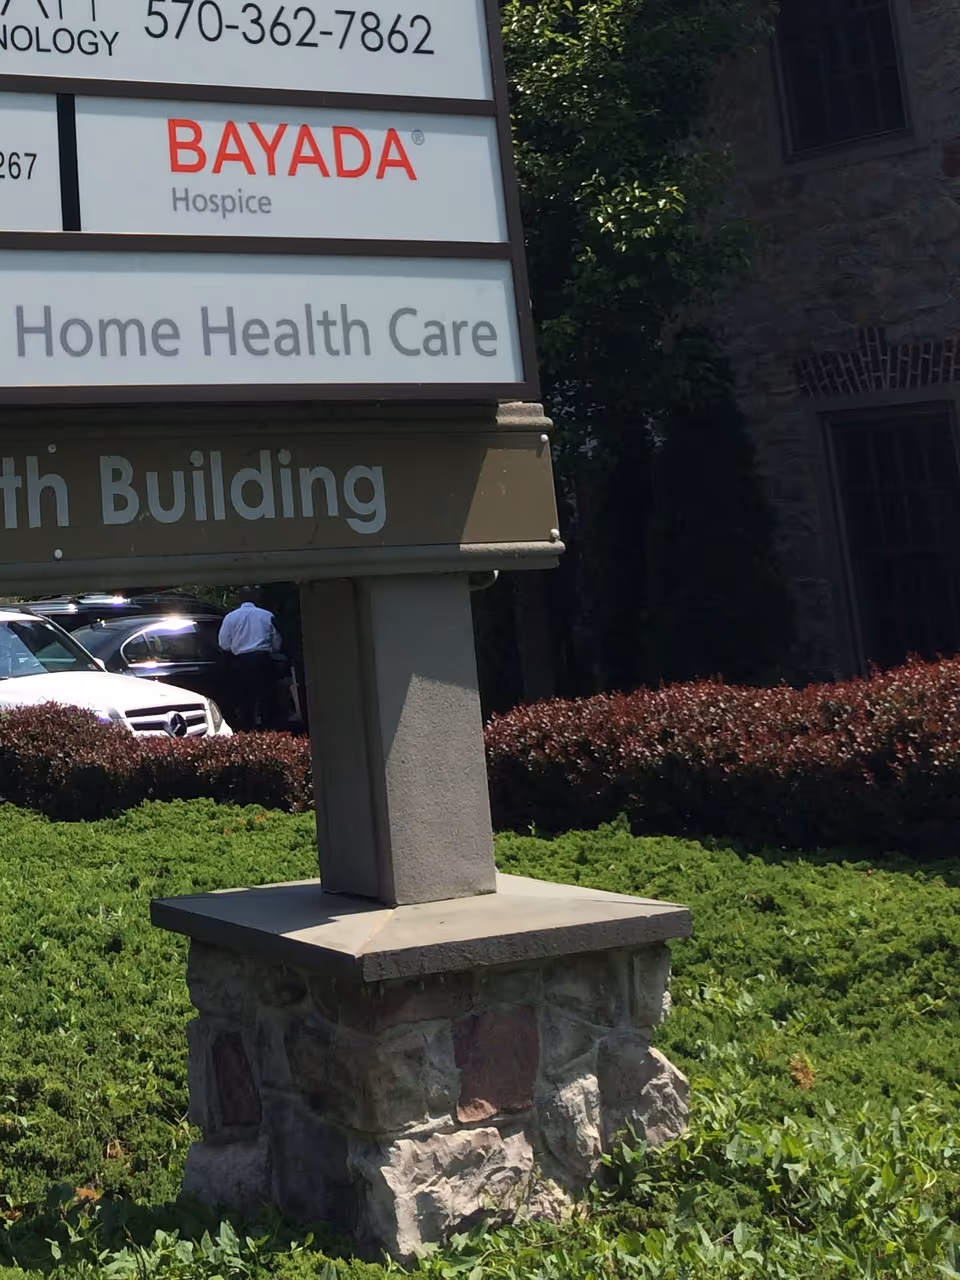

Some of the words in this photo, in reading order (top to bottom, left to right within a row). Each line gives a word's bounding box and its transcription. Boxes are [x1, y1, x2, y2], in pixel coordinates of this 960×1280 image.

[172, 187, 272, 219] Hospice
[15, 305, 180, 358] Home
[201, 303, 371, 357] Health
[389, 306, 498, 357] Care
[99, 448, 387, 535] Building
